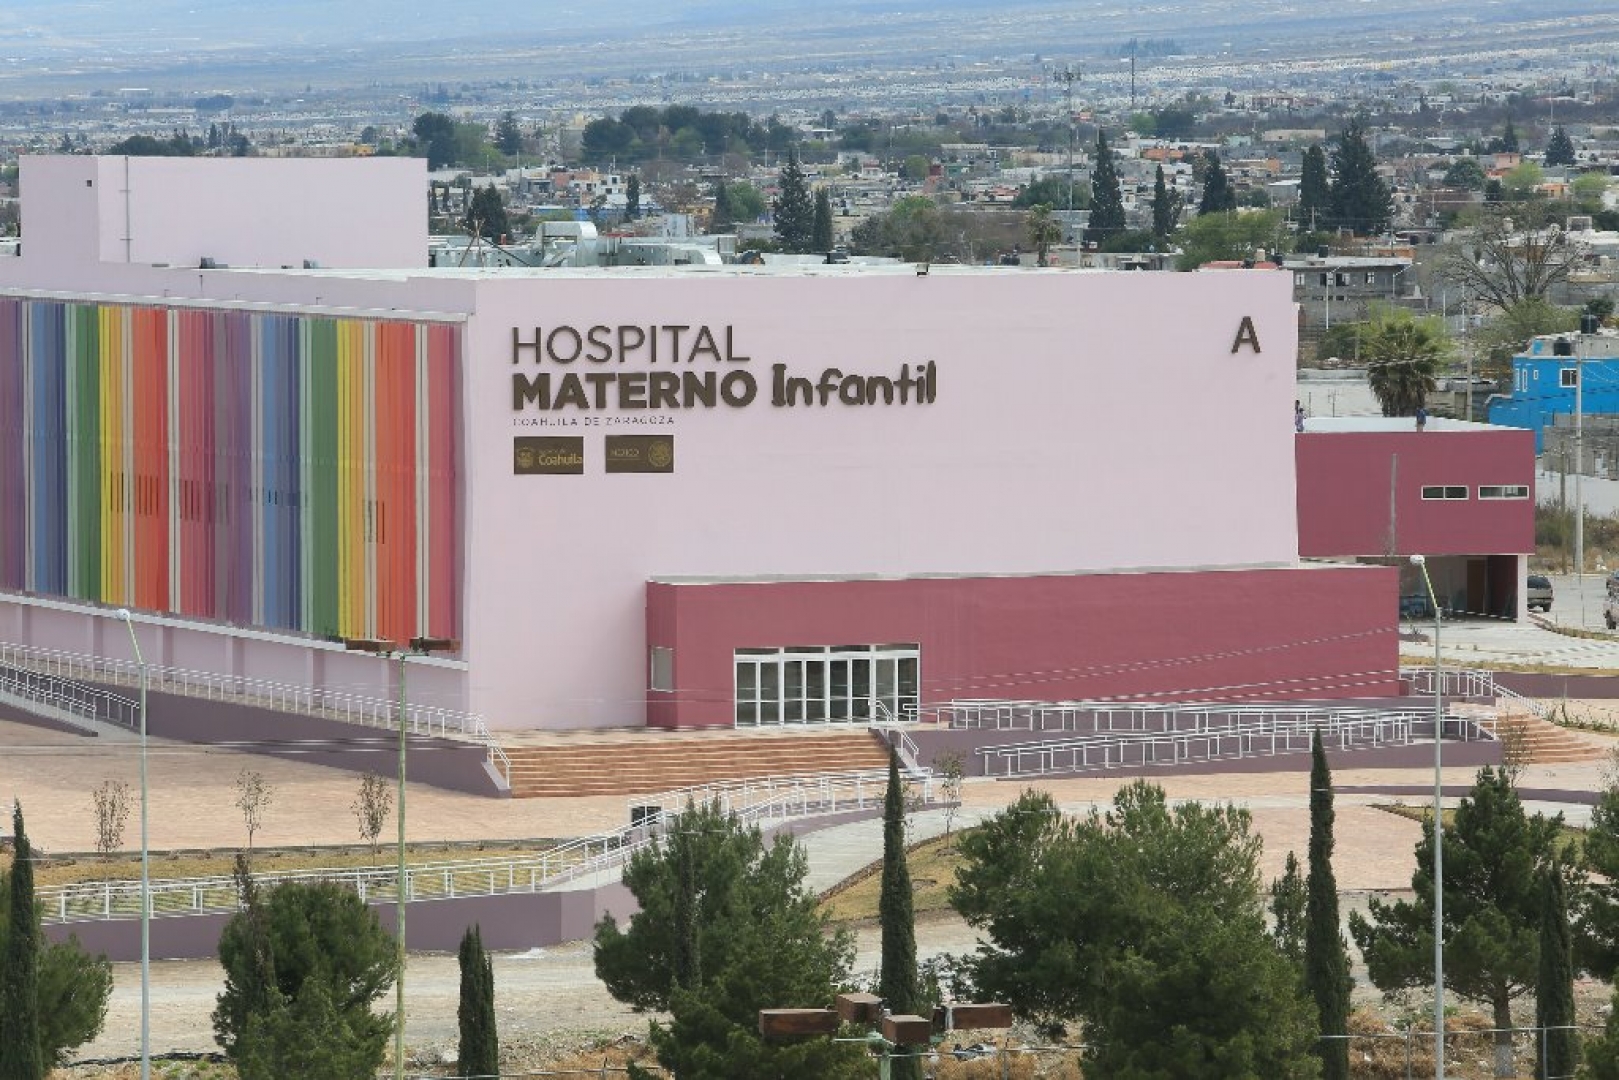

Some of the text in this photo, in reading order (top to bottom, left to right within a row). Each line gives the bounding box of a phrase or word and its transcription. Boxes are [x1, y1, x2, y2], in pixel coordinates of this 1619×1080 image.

[512, 325, 750, 364] HOSPITAL
[1230, 316, 1262, 355] A
[512, 360, 937, 411] MATERNO Infantil
[584, 416, 600, 427] DE
[538, 452, 583, 466] Coahuila
